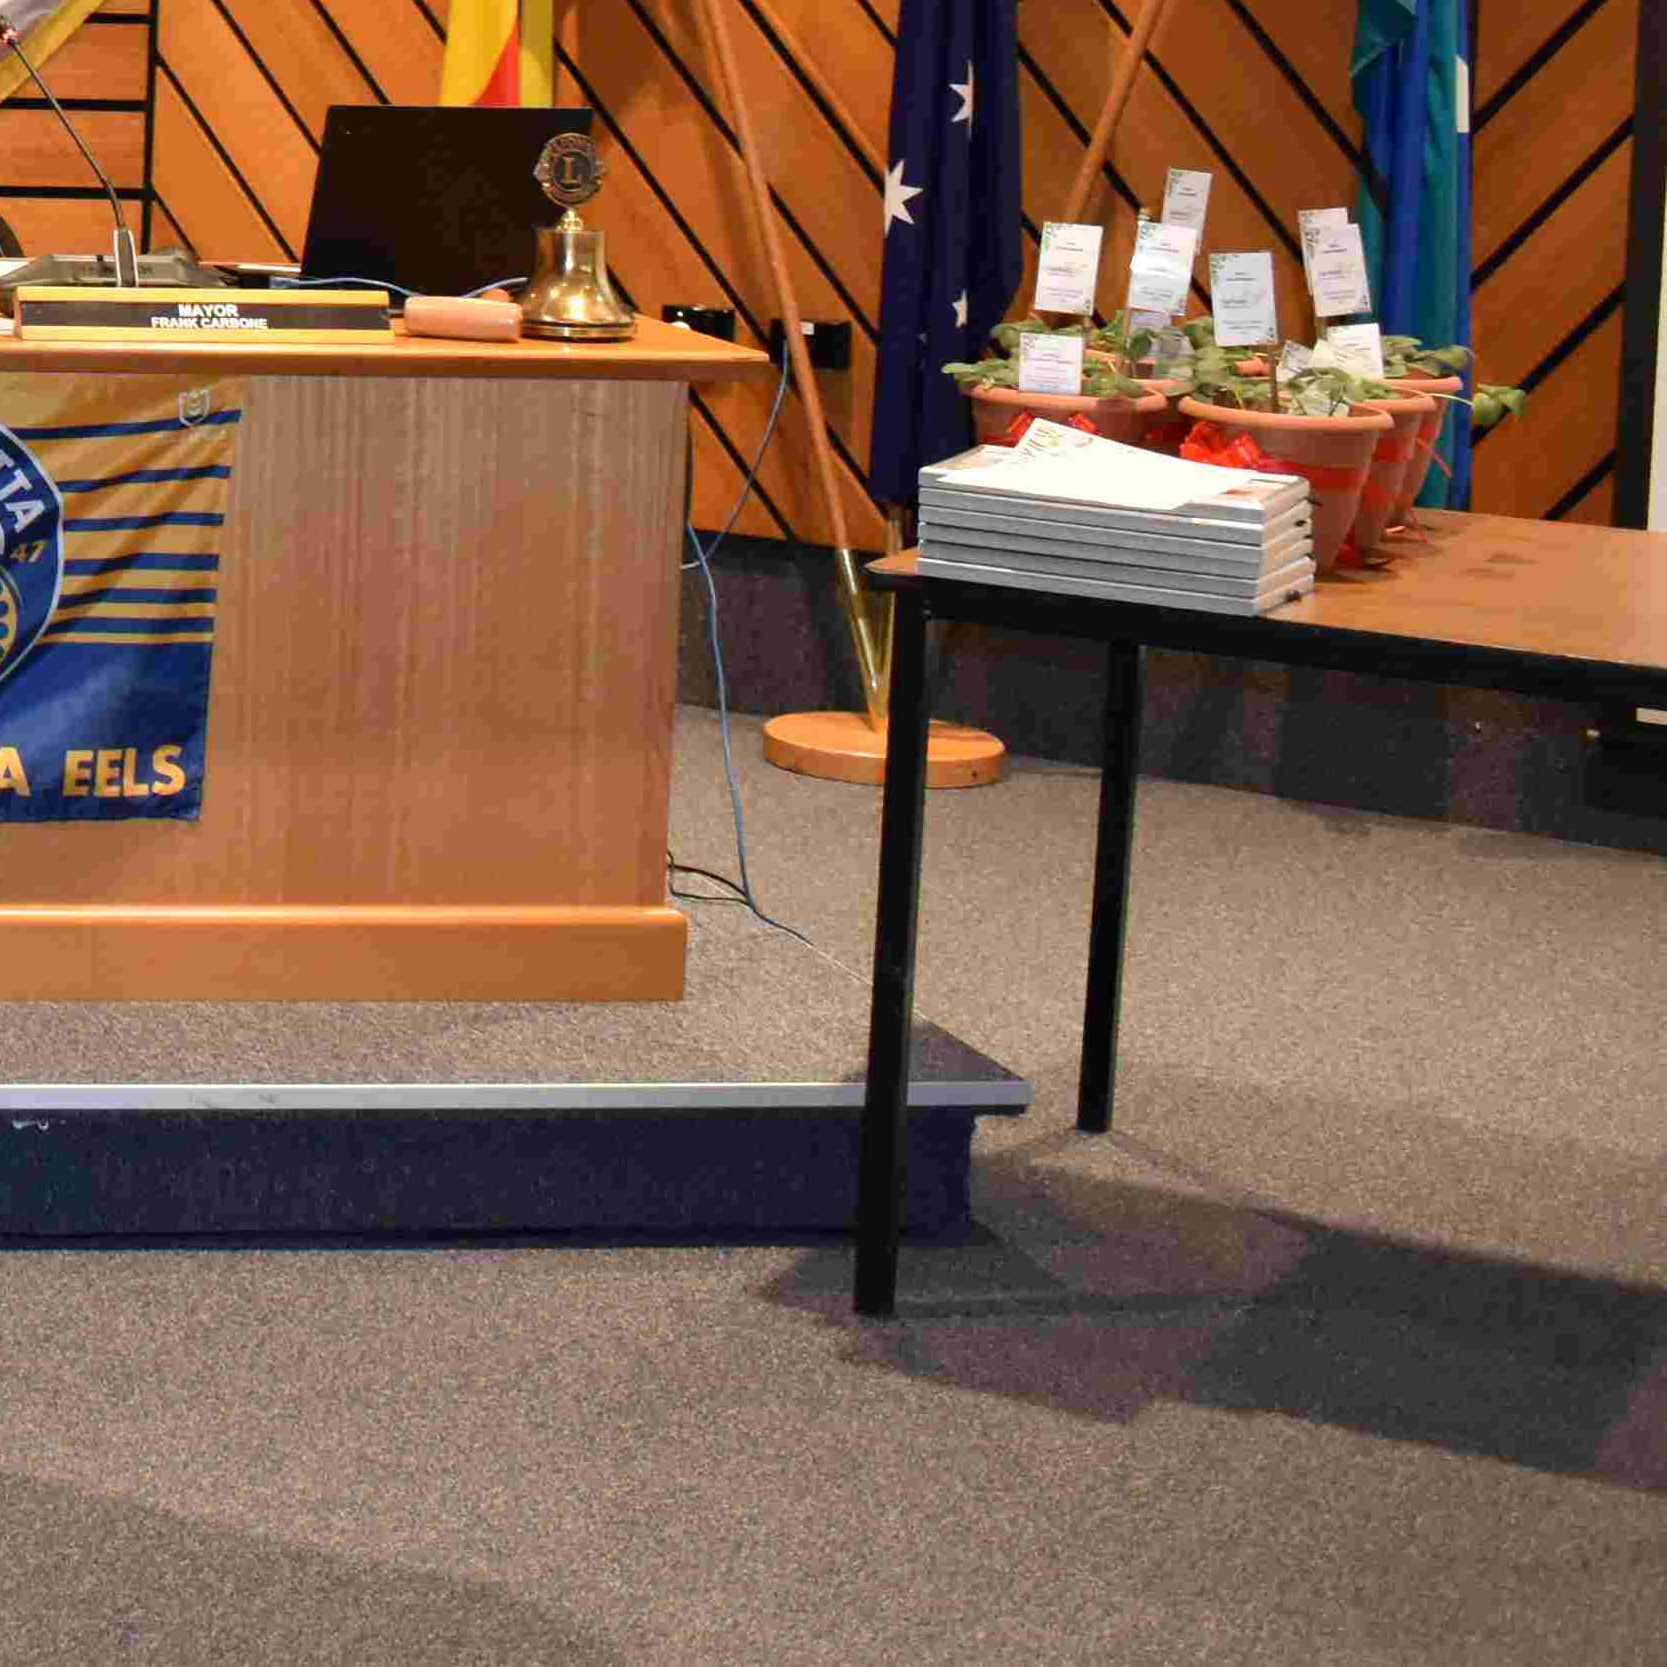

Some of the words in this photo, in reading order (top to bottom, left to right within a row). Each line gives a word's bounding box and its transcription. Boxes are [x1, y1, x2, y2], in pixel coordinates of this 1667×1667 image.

[178, 303, 239, 317] MAYOR
[151, 316, 198, 329] FRANK
[62, 744, 187, 799] EELS
